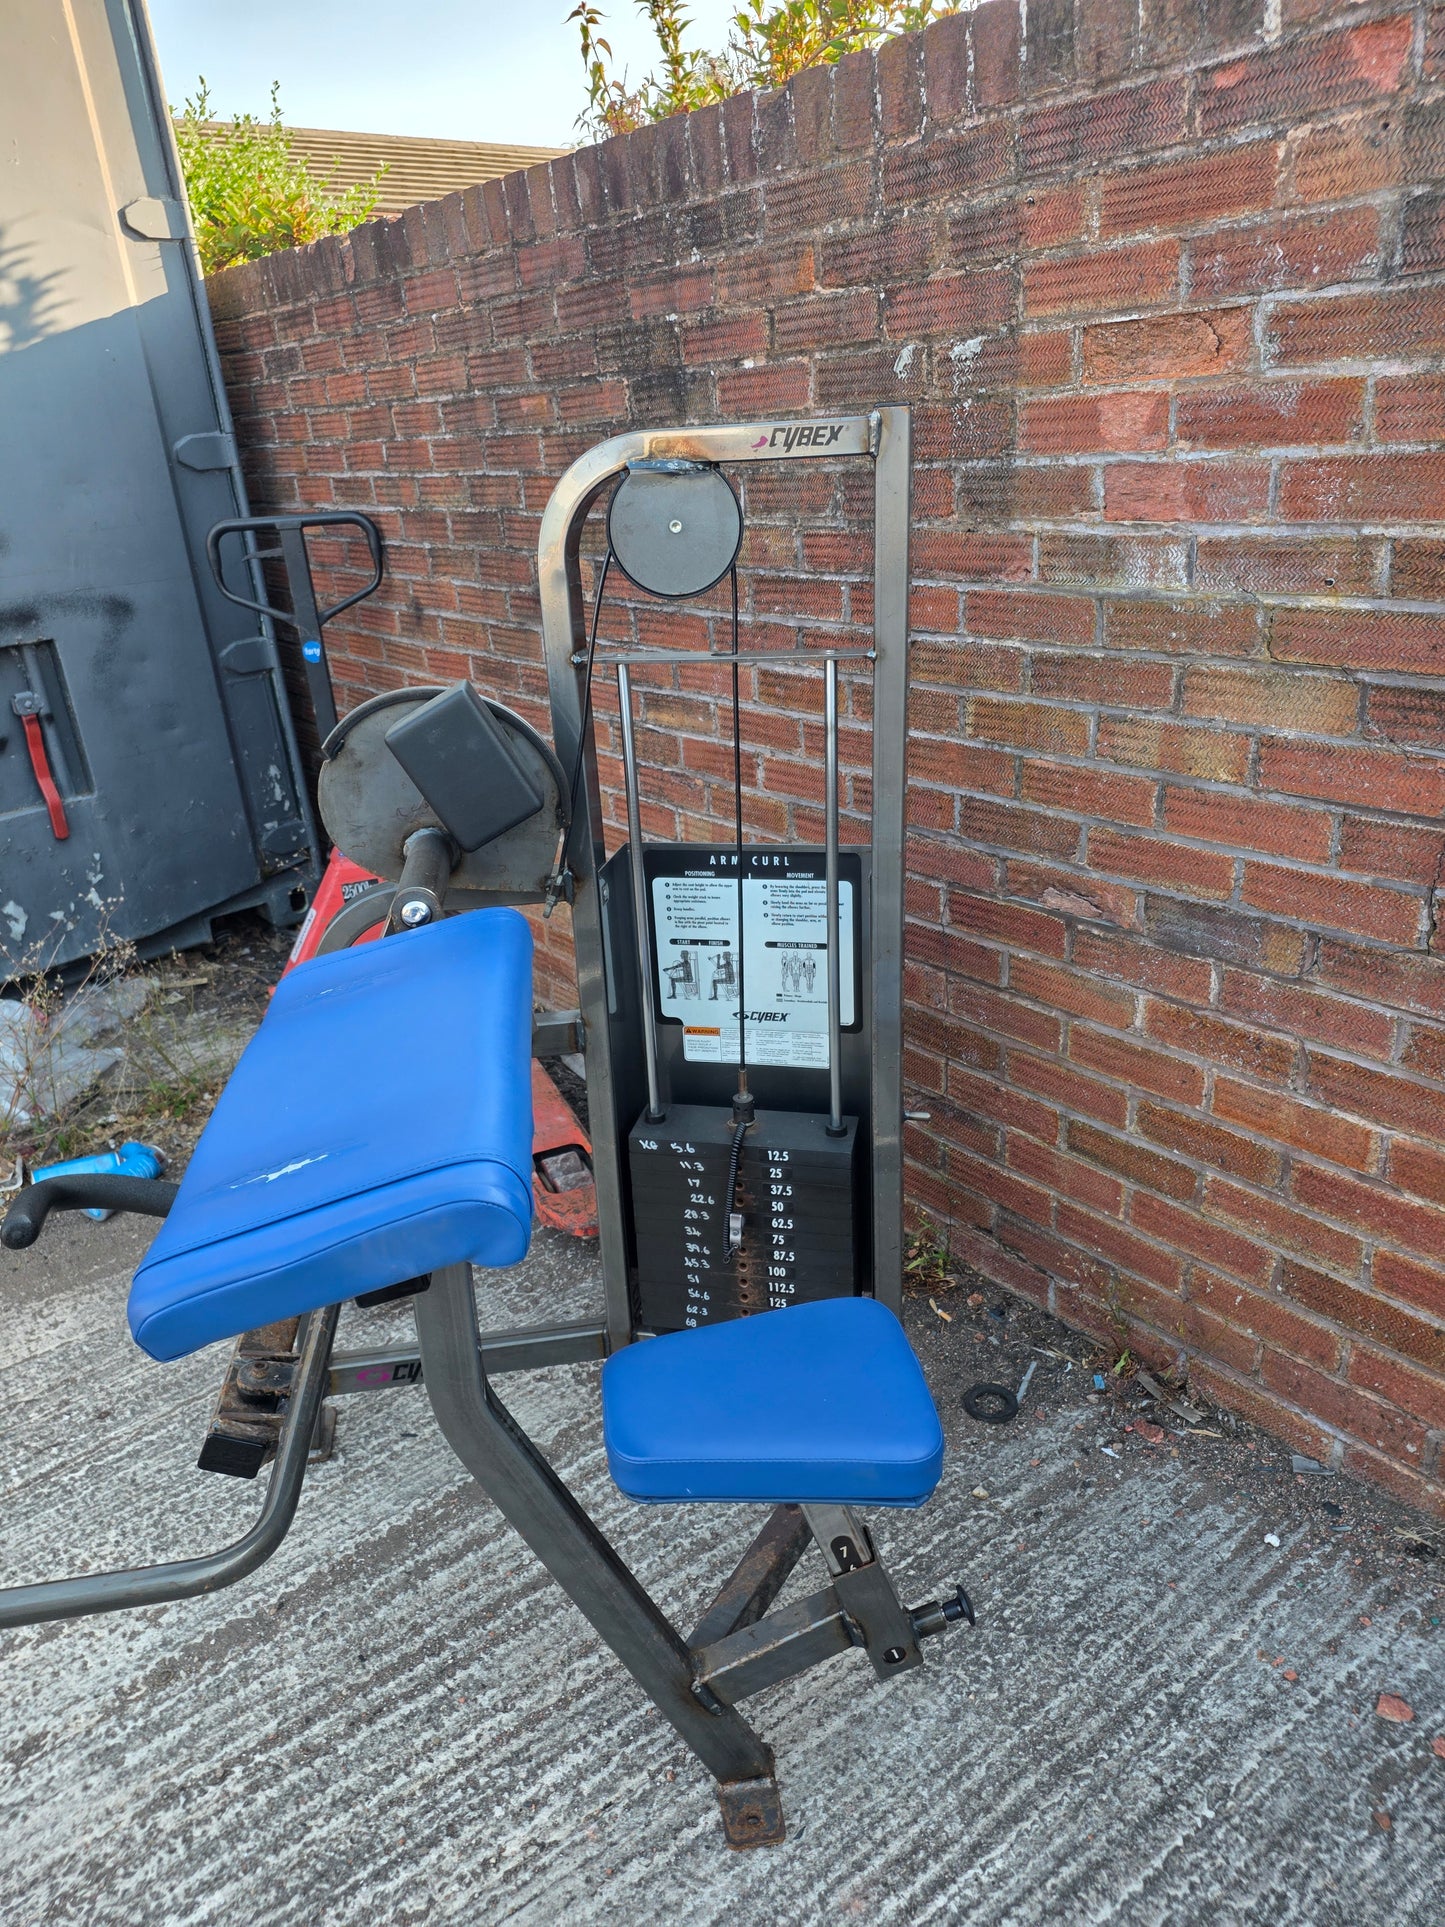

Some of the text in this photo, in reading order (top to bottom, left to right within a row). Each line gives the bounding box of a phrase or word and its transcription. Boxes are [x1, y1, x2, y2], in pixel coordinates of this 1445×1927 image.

[769, 425, 843, 453] CYBEX
[752, 856, 789, 866] CURL
[749, 1011, 788, 1023] CYBEX
[670, 1142, 696, 1154] 5.6
[767, 1150, 789, 1162] 12.5
[679, 1161, 705, 1172] 11.3
[769, 1168, 783, 1178] 25
[687, 1178, 700, 1188] 17
[770, 1185, 793, 1196] 37.5
[690, 1193, 715, 1205] 22.6
[771, 1201, 784, 1212] 50
[684, 1209, 710, 1220] 28.3
[771, 1218, 794, 1229] 62.5
[684, 1226, 702, 1237] 34
[772, 1234, 785, 1245] 75
[685, 1242, 710, 1255] 39.6
[773, 1250, 795, 1262] 87.5
[684, 1257, 710, 1269] 45.3
[768, 1266, 786, 1277] 100
[687, 1274, 700, 1284] 51
[768, 1282, 795, 1294] 112.5
[769, 1297, 787, 1308] 125
[686, 1304, 708, 1316] 62.3
[685, 1317, 697, 1328] 68
[839, 1545, 847, 1558] 7
[891, 1649, 900, 1659] 1
